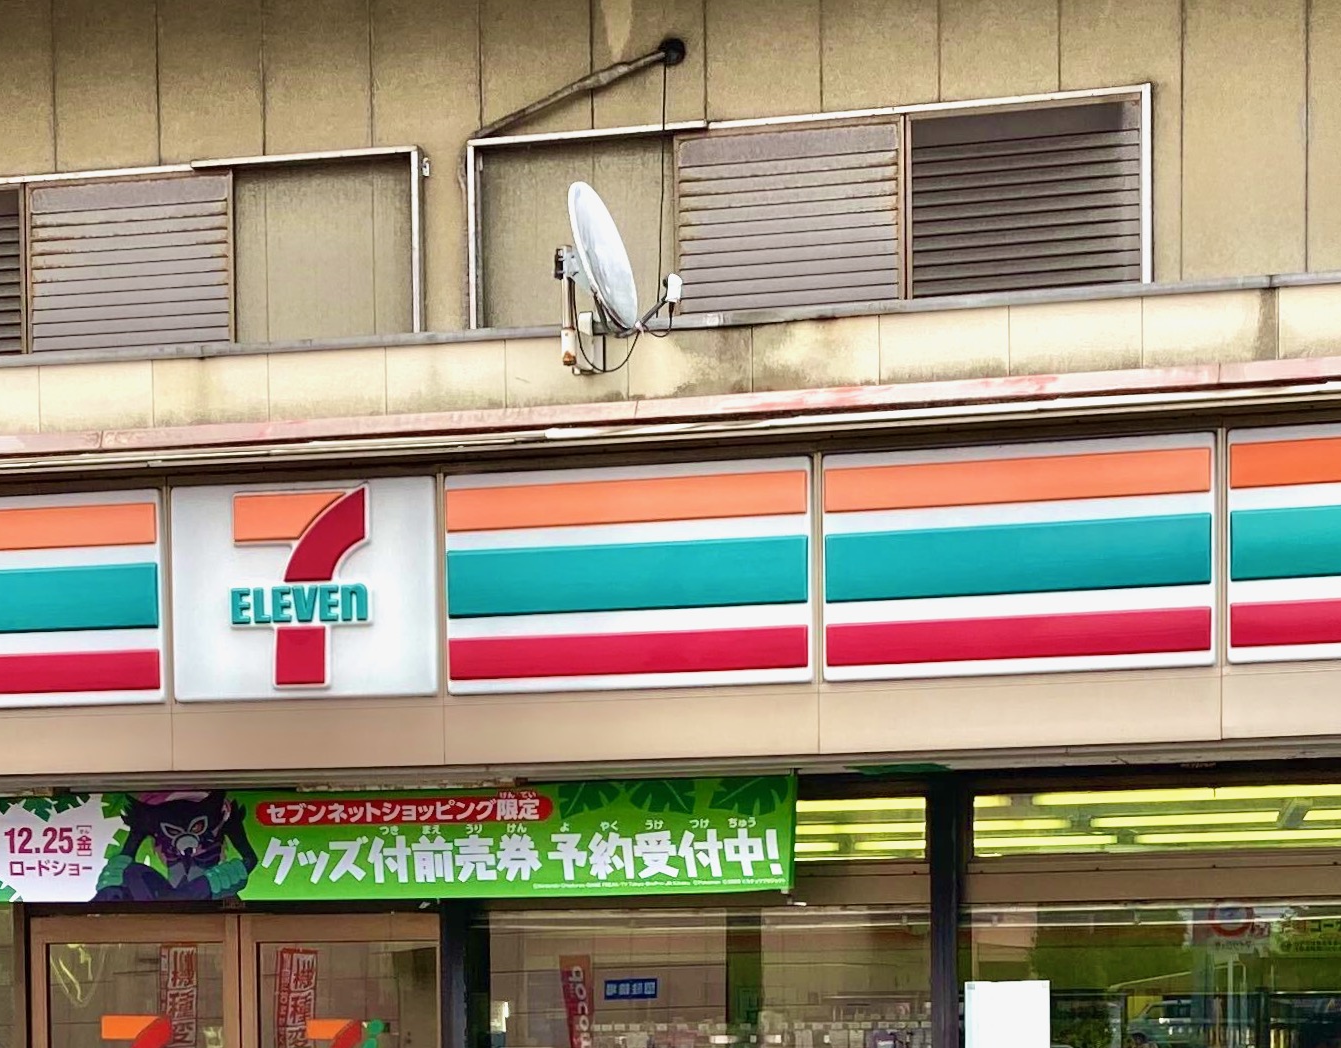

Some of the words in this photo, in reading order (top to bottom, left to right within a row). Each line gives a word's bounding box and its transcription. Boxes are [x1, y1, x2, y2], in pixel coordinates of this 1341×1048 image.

[266, 798, 541, 825] セブンネットショッピング限定
[4, 826, 74, 855] 12.25
[9, 860, 94, 877] ロードショー
[261, 833, 542, 885] グッズ付前売券
